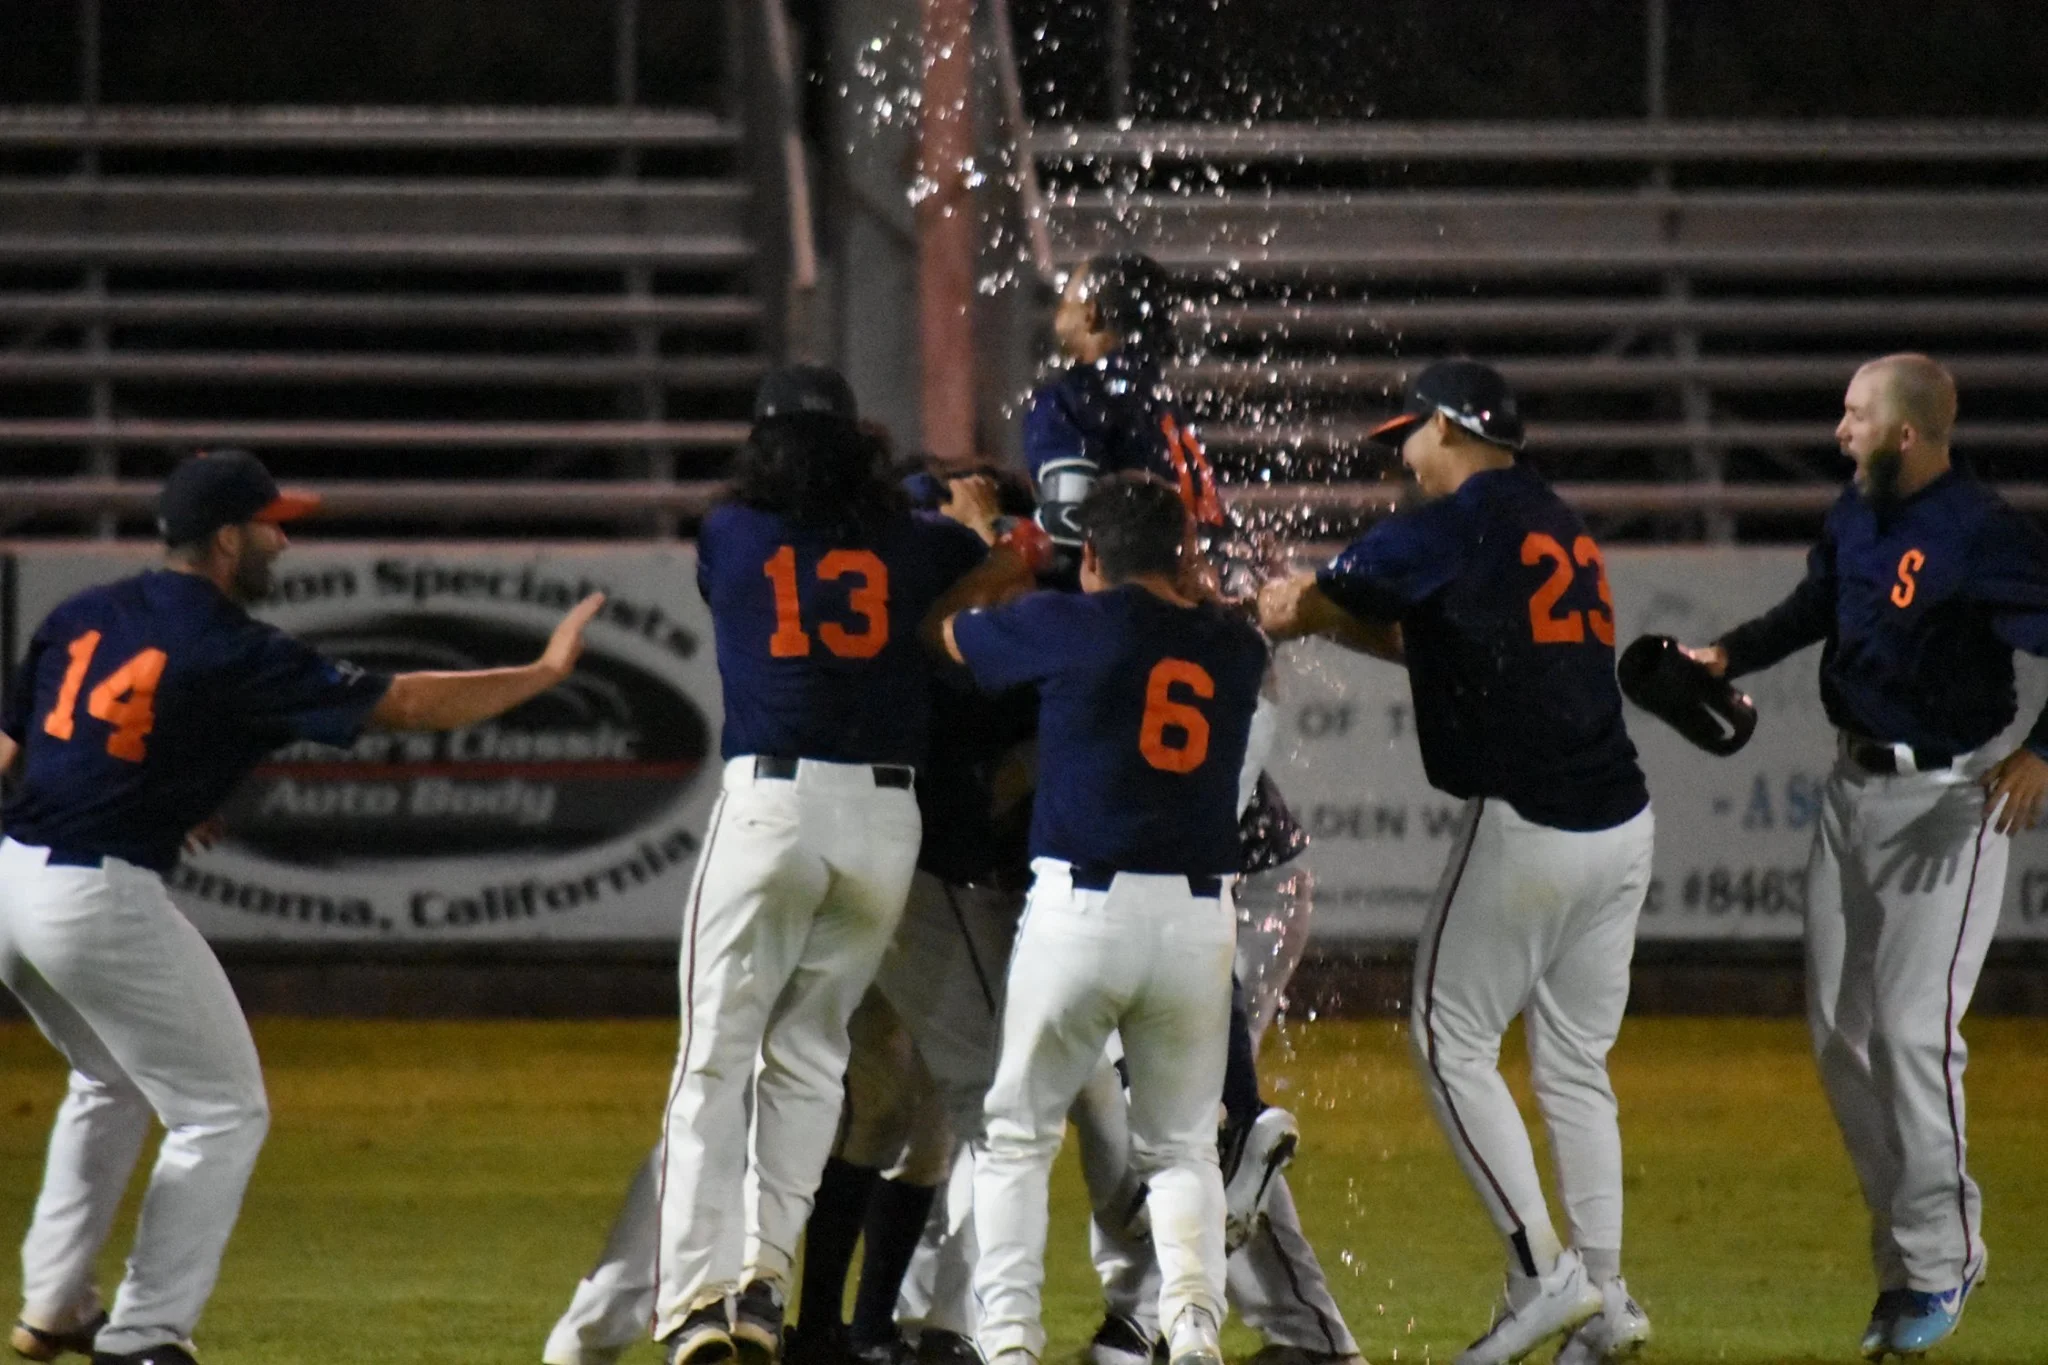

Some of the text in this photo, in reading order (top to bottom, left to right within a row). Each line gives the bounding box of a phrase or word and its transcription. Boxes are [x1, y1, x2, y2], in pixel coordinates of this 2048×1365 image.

[281, 565, 357, 602] on
[763, 545, 889, 659] 13
[1520, 531, 1615, 647] 23
[1890, 548, 1926, 609] S
[43, 628, 168, 762] 14
[1138, 656, 1215, 774] 6
[1297, 702, 1356, 739] OF
[262, 777, 556, 824] Auto Body
[171, 829, 699, 931] onoma, California
